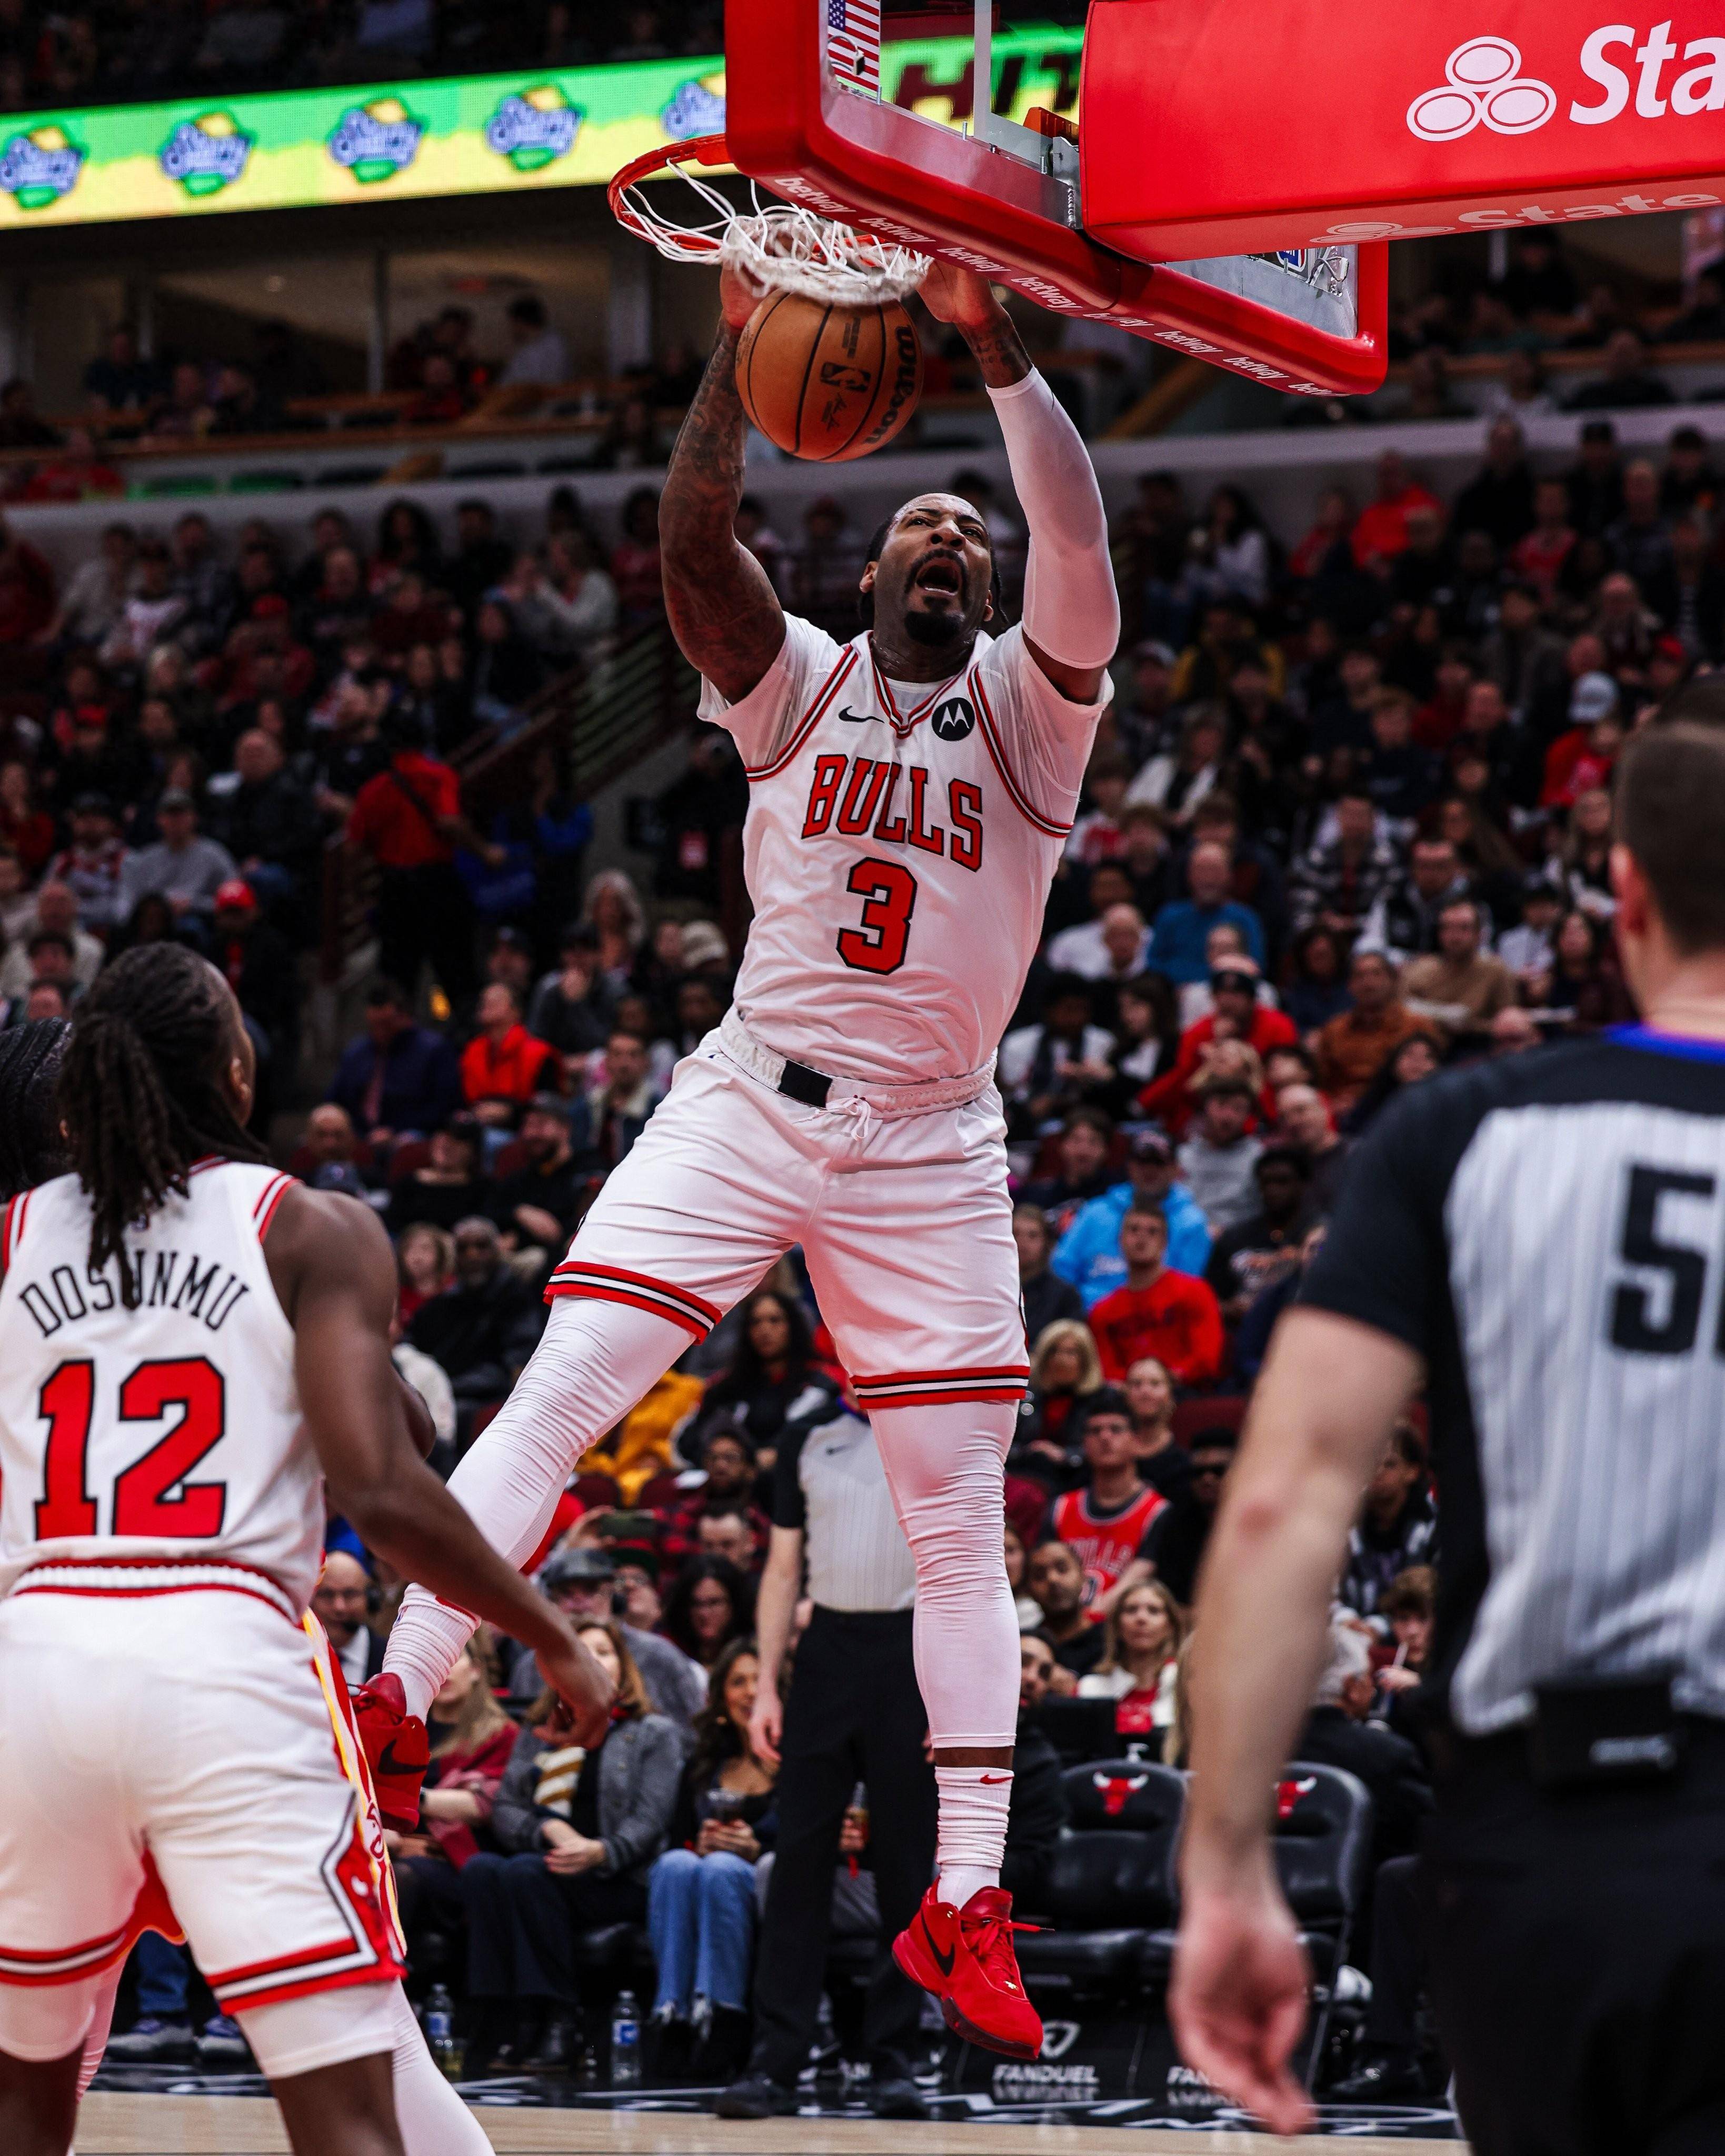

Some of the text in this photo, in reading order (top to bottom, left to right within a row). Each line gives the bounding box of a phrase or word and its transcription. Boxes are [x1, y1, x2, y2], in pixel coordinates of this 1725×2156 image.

[1458, 194, 1722, 229] State
[775, 177, 856, 213] betway
[858, 217, 936, 243] betway
[936, 247, 1012, 272] betway
[1010, 276, 1083, 308] betway
[1154, 331, 1224, 353] betway
[1222, 357, 1290, 379] betway
[801, 754, 983, 873] BULLS
[836, 856, 918, 975] 3
[1612, 1165, 1725, 1355] 5
[33, 1355, 227, 1541] 12
[992, 2064, 1100, 2084] FANDUEL
